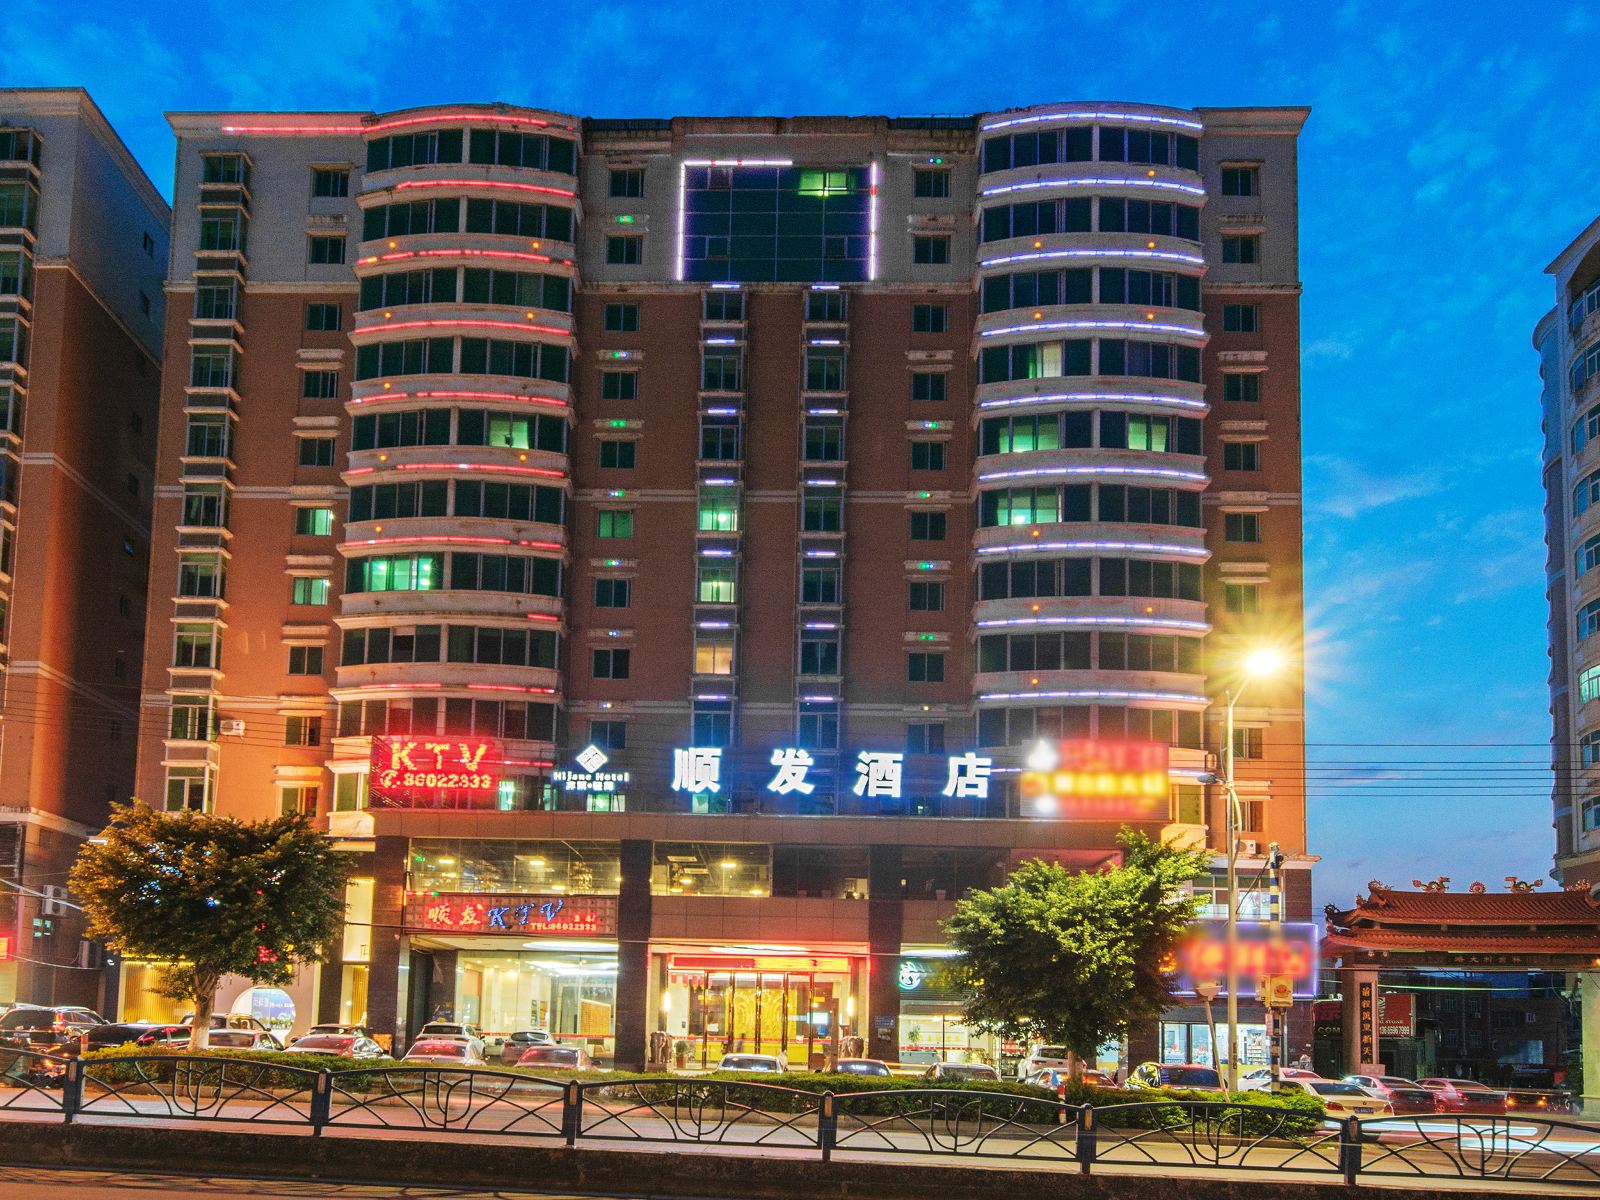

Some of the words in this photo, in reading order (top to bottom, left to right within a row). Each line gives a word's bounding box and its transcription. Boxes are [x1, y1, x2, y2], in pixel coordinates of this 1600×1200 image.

[391, 742, 487, 771] KTV
[672, 747, 992, 798] 顺发酒店
[488, 898, 564, 929] KTV
